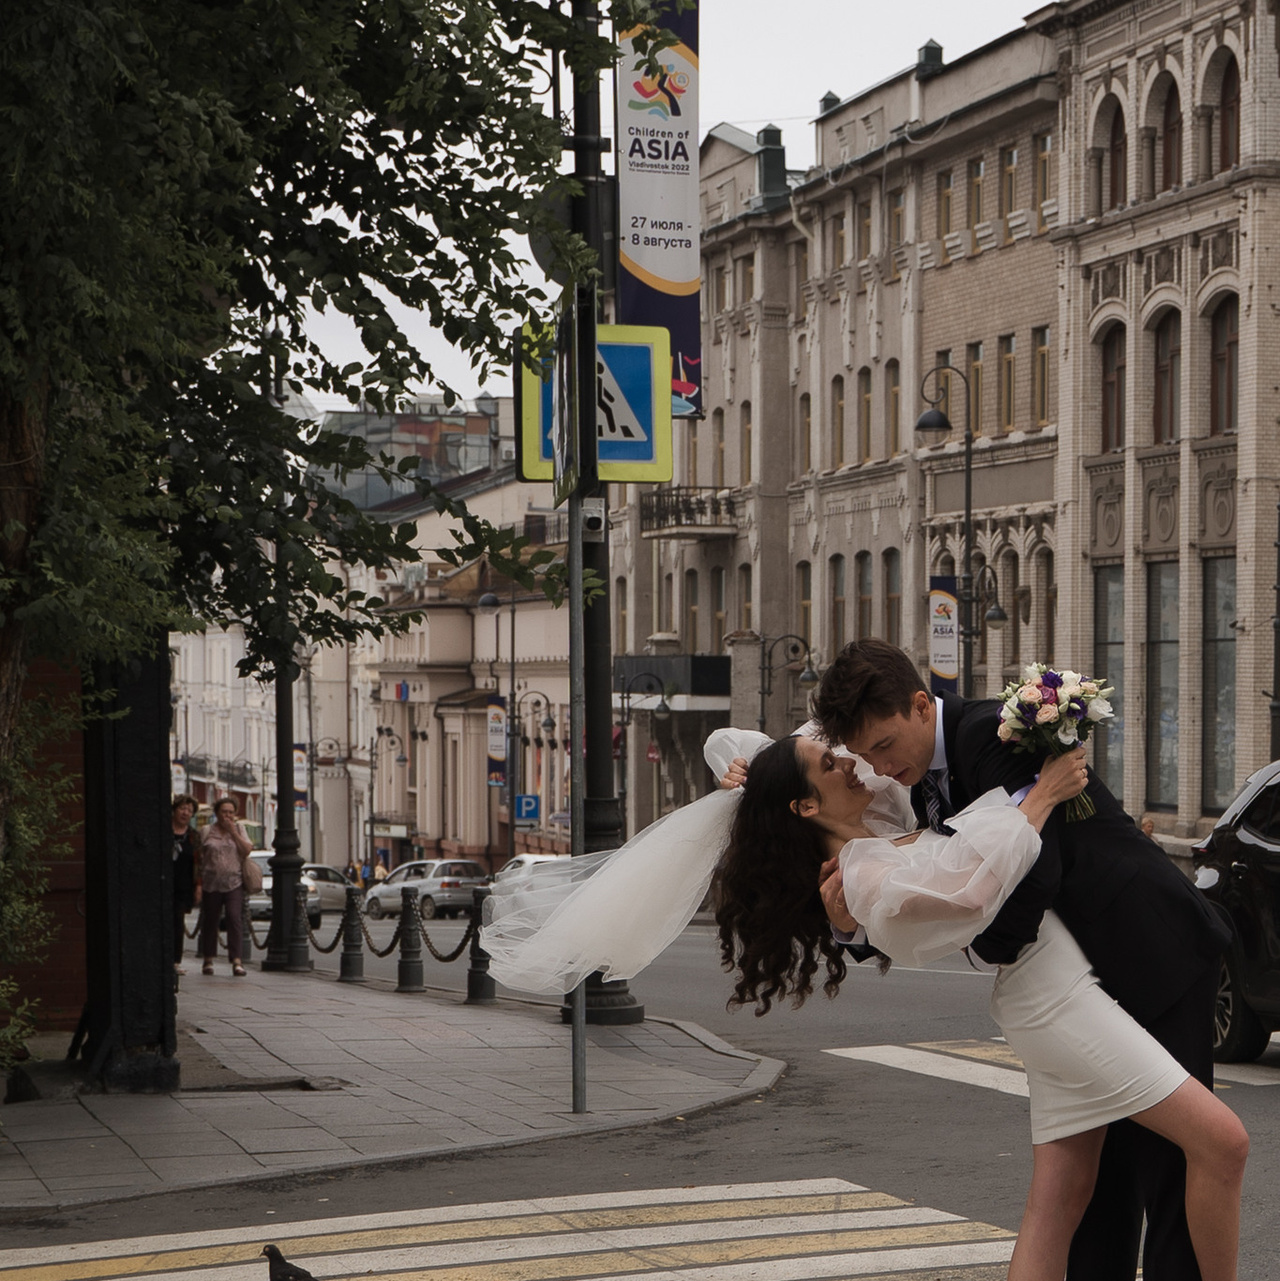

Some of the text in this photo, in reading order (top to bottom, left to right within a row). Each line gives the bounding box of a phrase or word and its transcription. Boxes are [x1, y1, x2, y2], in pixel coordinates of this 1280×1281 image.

[628, 126, 689, 139] Children of
[628, 138, 690, 162] ASIA
[628, 161, 690, 171] Vladivostok 2022
[631, 216, 647, 229] 27
[650, 220, 684, 231] июля
[631, 233, 692, 250] 8 августа
[522, 798, 536, 817] P
